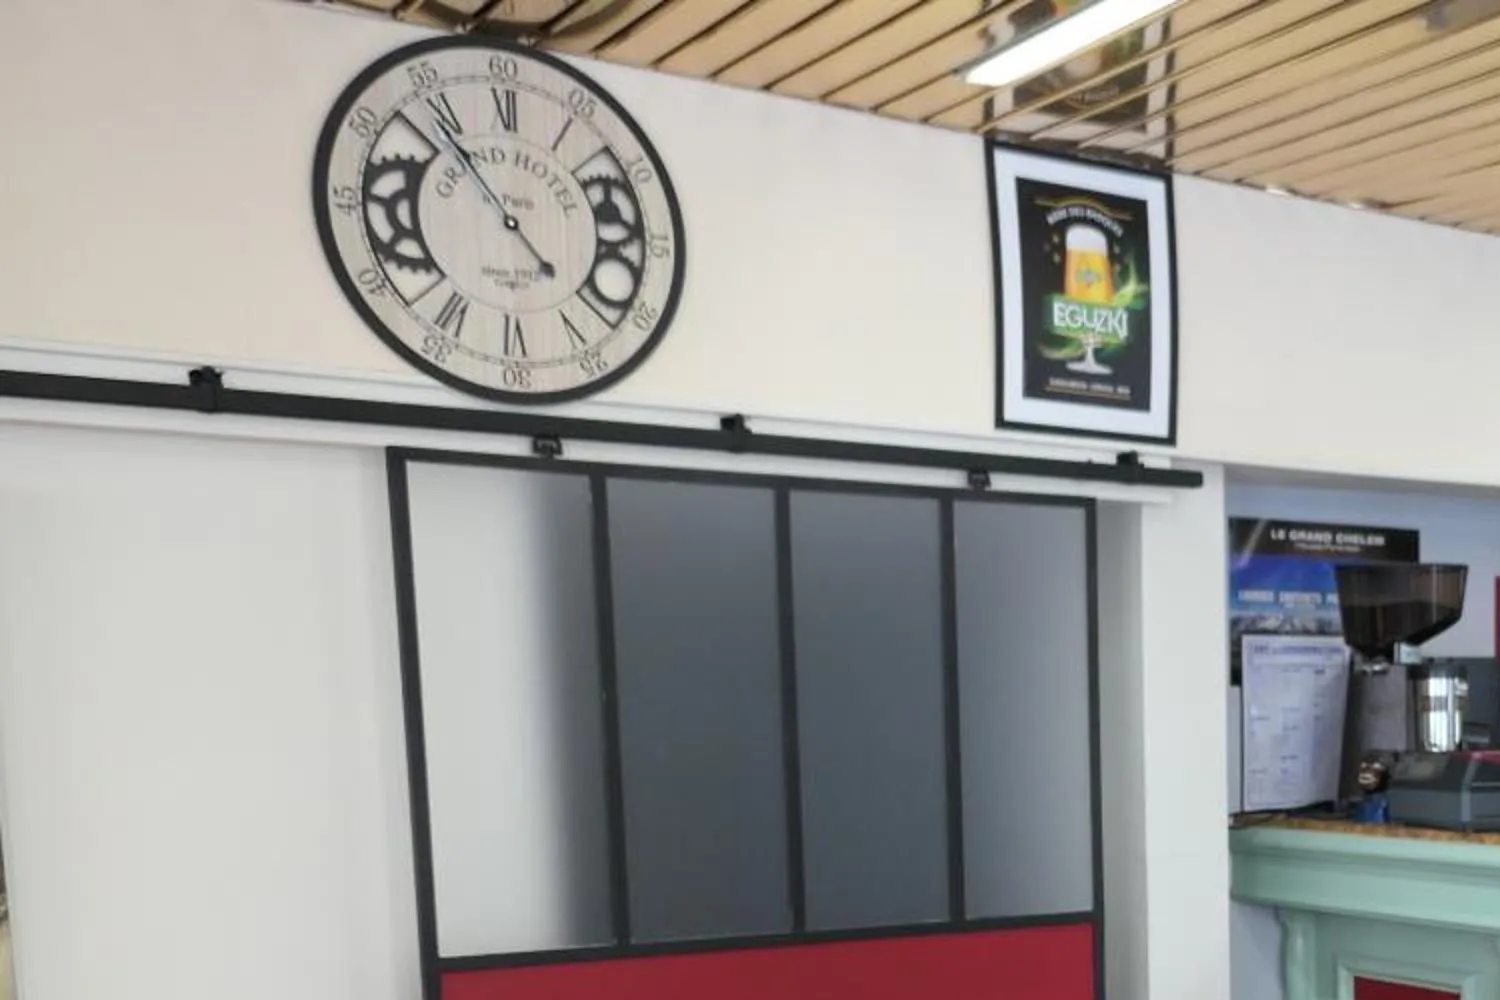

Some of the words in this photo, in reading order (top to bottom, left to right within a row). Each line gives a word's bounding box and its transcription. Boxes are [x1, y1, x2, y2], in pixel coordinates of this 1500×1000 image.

[407, 61, 438, 88] 55
[489, 55, 518, 80] 60
[569, 88, 597, 118] 05
[349, 106, 377, 138] 50
[627, 154, 653, 185] 10
[514, 150, 578, 219] HOTEL
[333, 185, 360, 217] 45
[649, 232, 671, 259] 15
[358, 268, 388, 297] 40
[633, 301, 658, 331] 20
[1053, 302, 1128, 340] EGUZKI
[421, 335, 452, 363] 35
[578, 350, 608, 376] 25
[503, 366, 532, 388] 30
